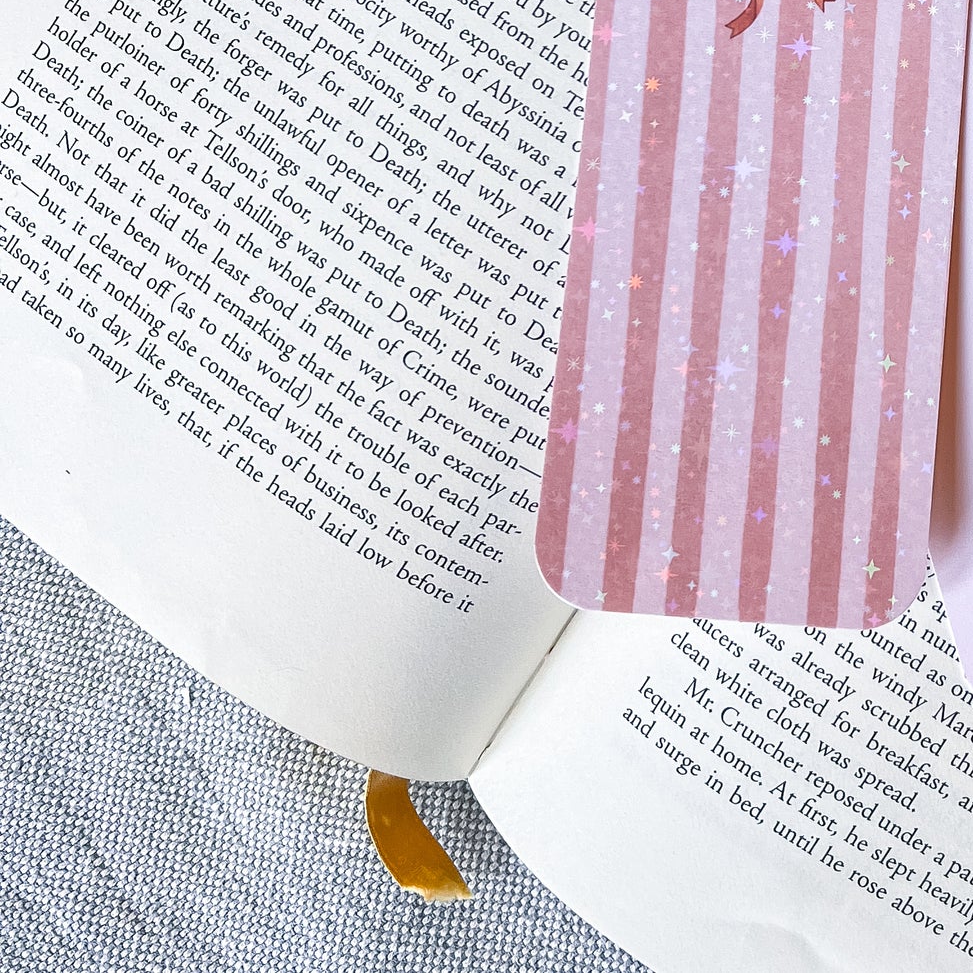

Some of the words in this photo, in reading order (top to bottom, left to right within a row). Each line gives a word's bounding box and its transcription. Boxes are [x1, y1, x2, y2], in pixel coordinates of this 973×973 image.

[177, 411, 212, 448] that,
[217, 439, 240, 459] if
[235, 455, 263, 483] the
[265, 474, 316, 521] heads
[318, 512, 358, 547] laid
[356, 537, 393, 569] low
[396, 560, 454, 604] before
[456, 594, 474, 611] it
[713, 735, 763, 786] home.
[768, 780, 797, 806] At
[798, 798, 837, 836] first,
[843, 825, 868, 851] he
[870, 847, 917, 882] slept
